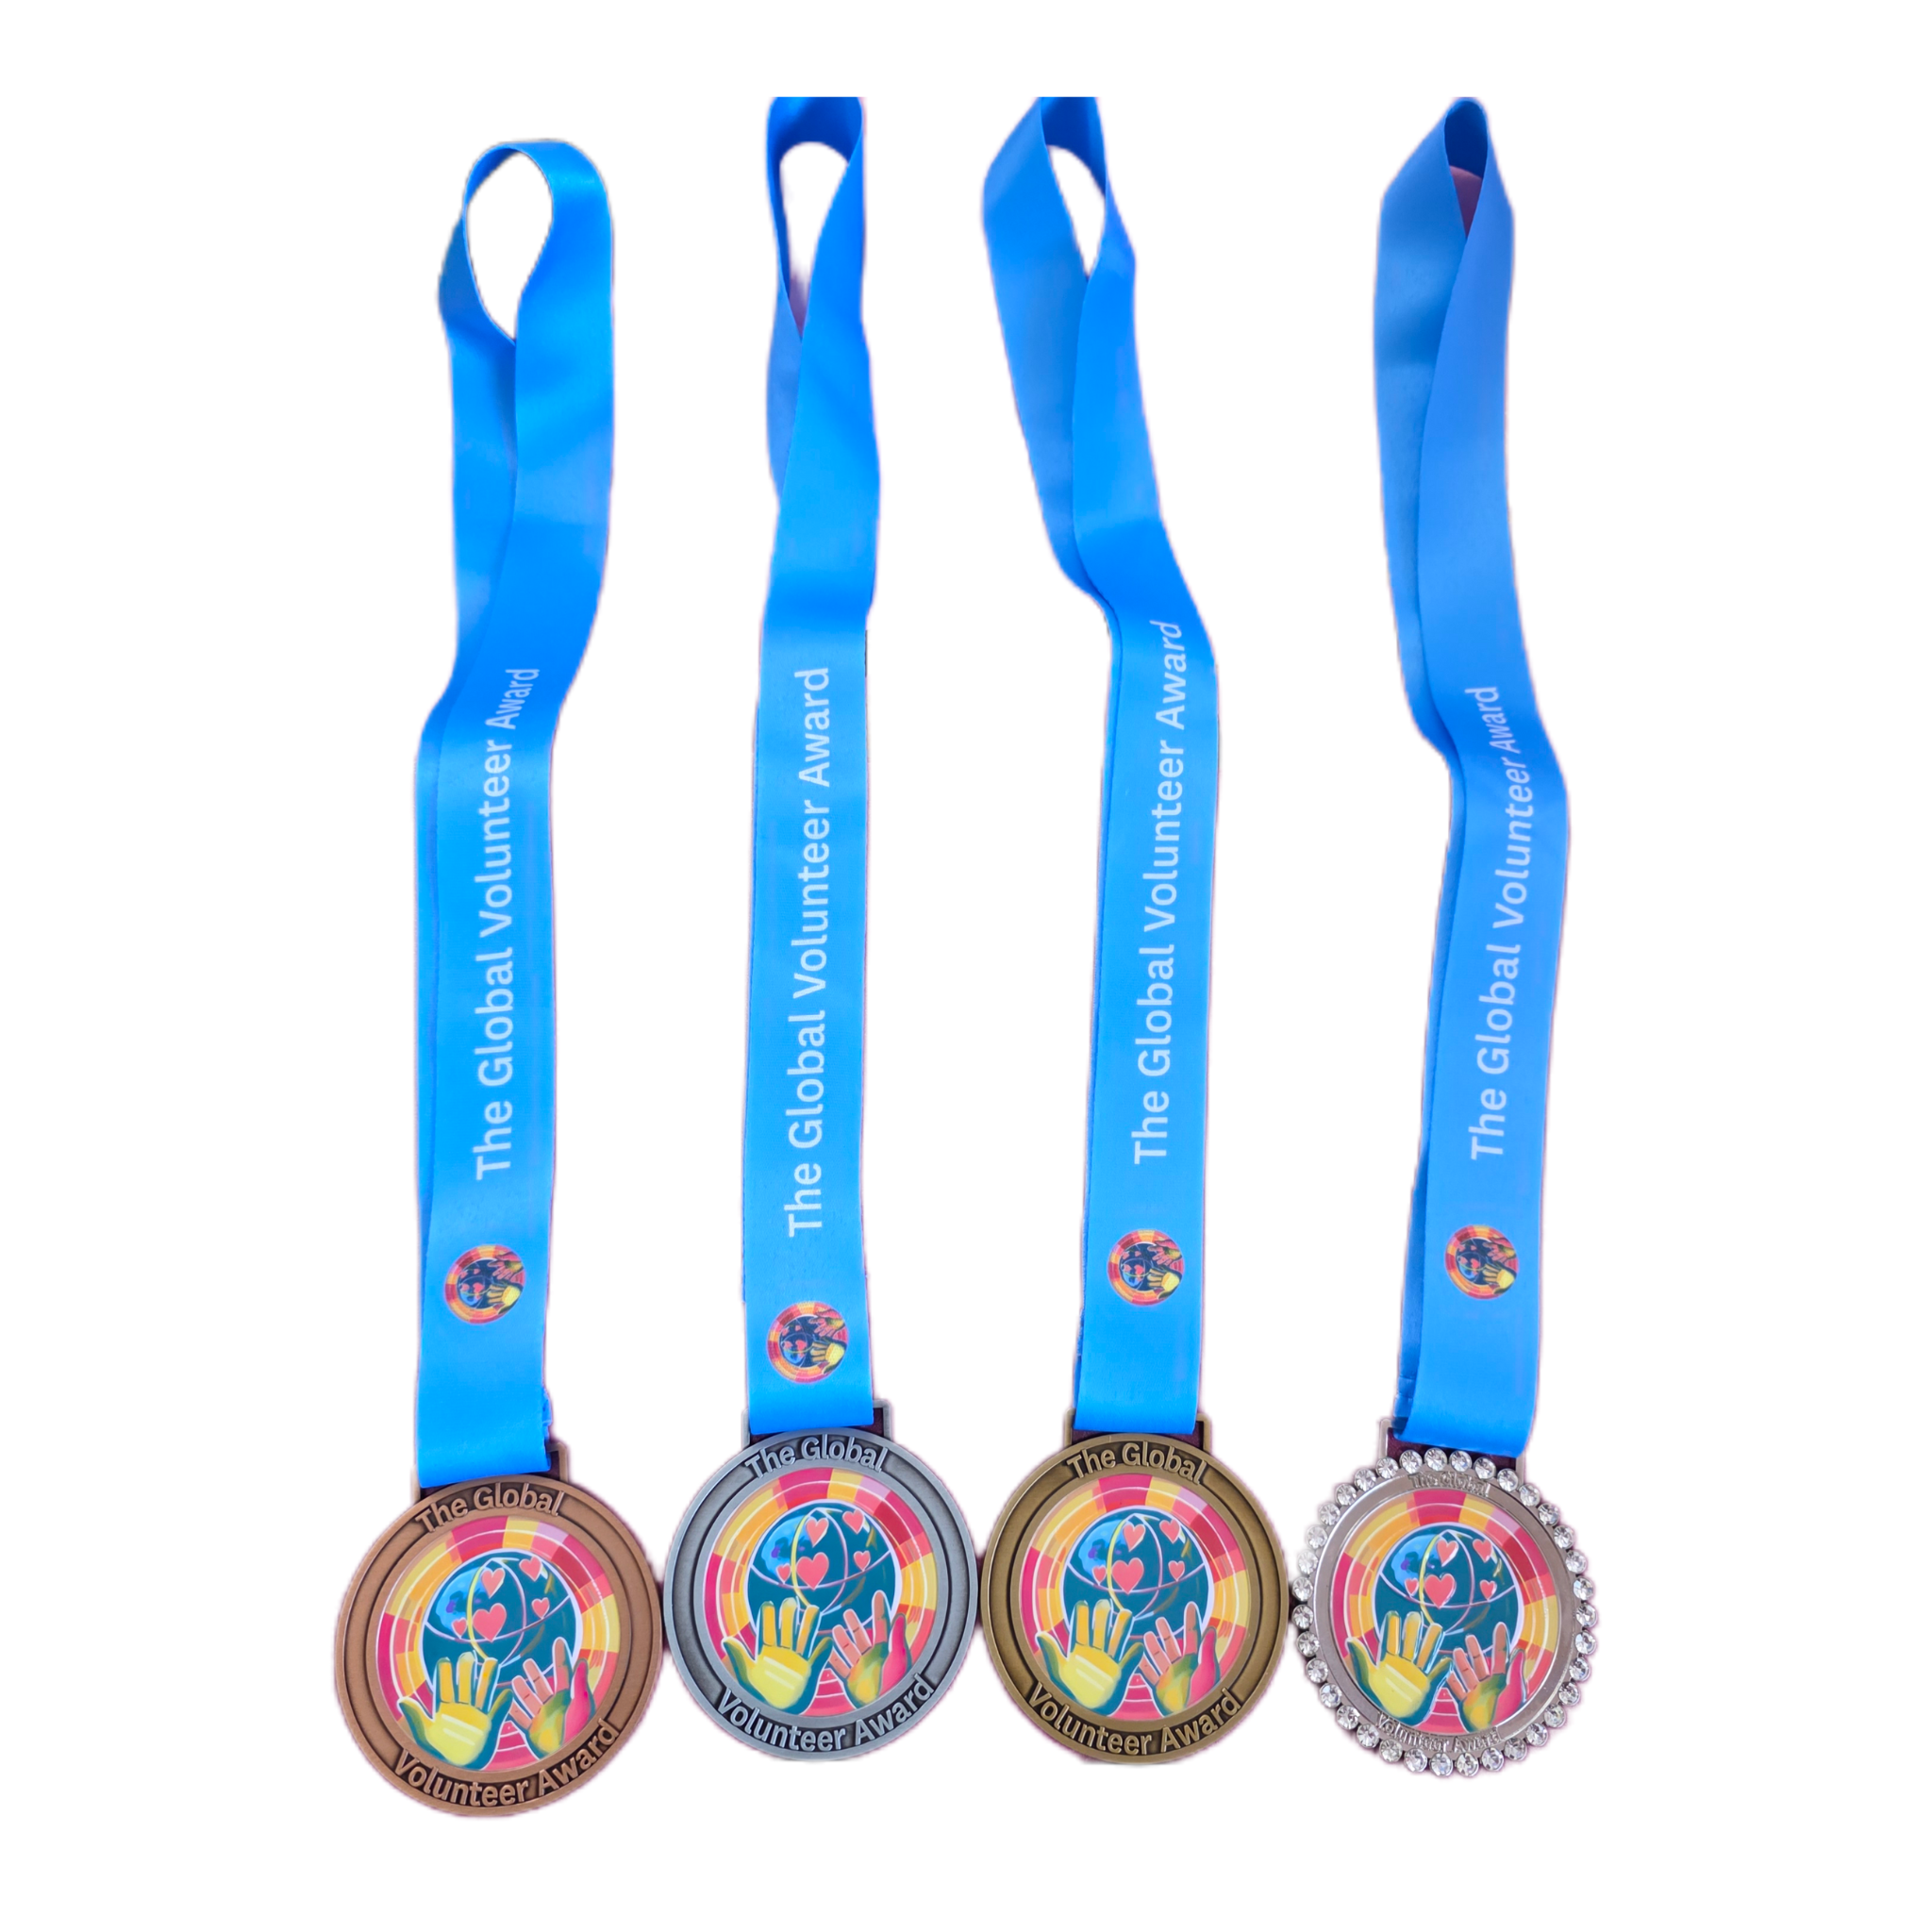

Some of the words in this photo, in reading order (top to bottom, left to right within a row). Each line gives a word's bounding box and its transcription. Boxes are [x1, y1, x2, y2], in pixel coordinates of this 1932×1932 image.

[485, 668, 541, 731] Award
[1149, 619, 1188, 731] Award
[792, 667, 830, 788] Award
[1464, 686, 1522, 755] Award
[474, 739, 513, 939] Volunteer
[1141, 739, 1186, 933] Volunteer
[1492, 757, 1534, 929] Volunteer
[791, 798, 830, 999] Volunteer
[474, 946, 514, 1087] Global
[1134, 943, 1175, 1077] Global
[1474, 944, 1521, 1075] Global
[785, 1009, 826, 1149] Global
[472, 1100, 513, 1181] The
[1130, 1091, 1170, 1165] The
[1468, 1088, 1507, 1160] The
[783, 1162, 823, 1239] The
[743, 1445, 797, 1479] The
[801, 1434, 889, 1474] Global
[1066, 1448, 1117, 1480] The
[1121, 1441, 1209, 1486] Global
[415, 1495, 469, 1534] The
[473, 1482, 565, 1518] Global
[714, 1687, 847, 1752] Volunteer
[854, 1673, 936, 1746] Award
[1026, 1681, 1153, 1756] Volunteer
[1158, 1688, 1243, 1753] Award
[393, 1750, 530, 1807] Volunteer
[536, 1717, 619, 1797] Award
